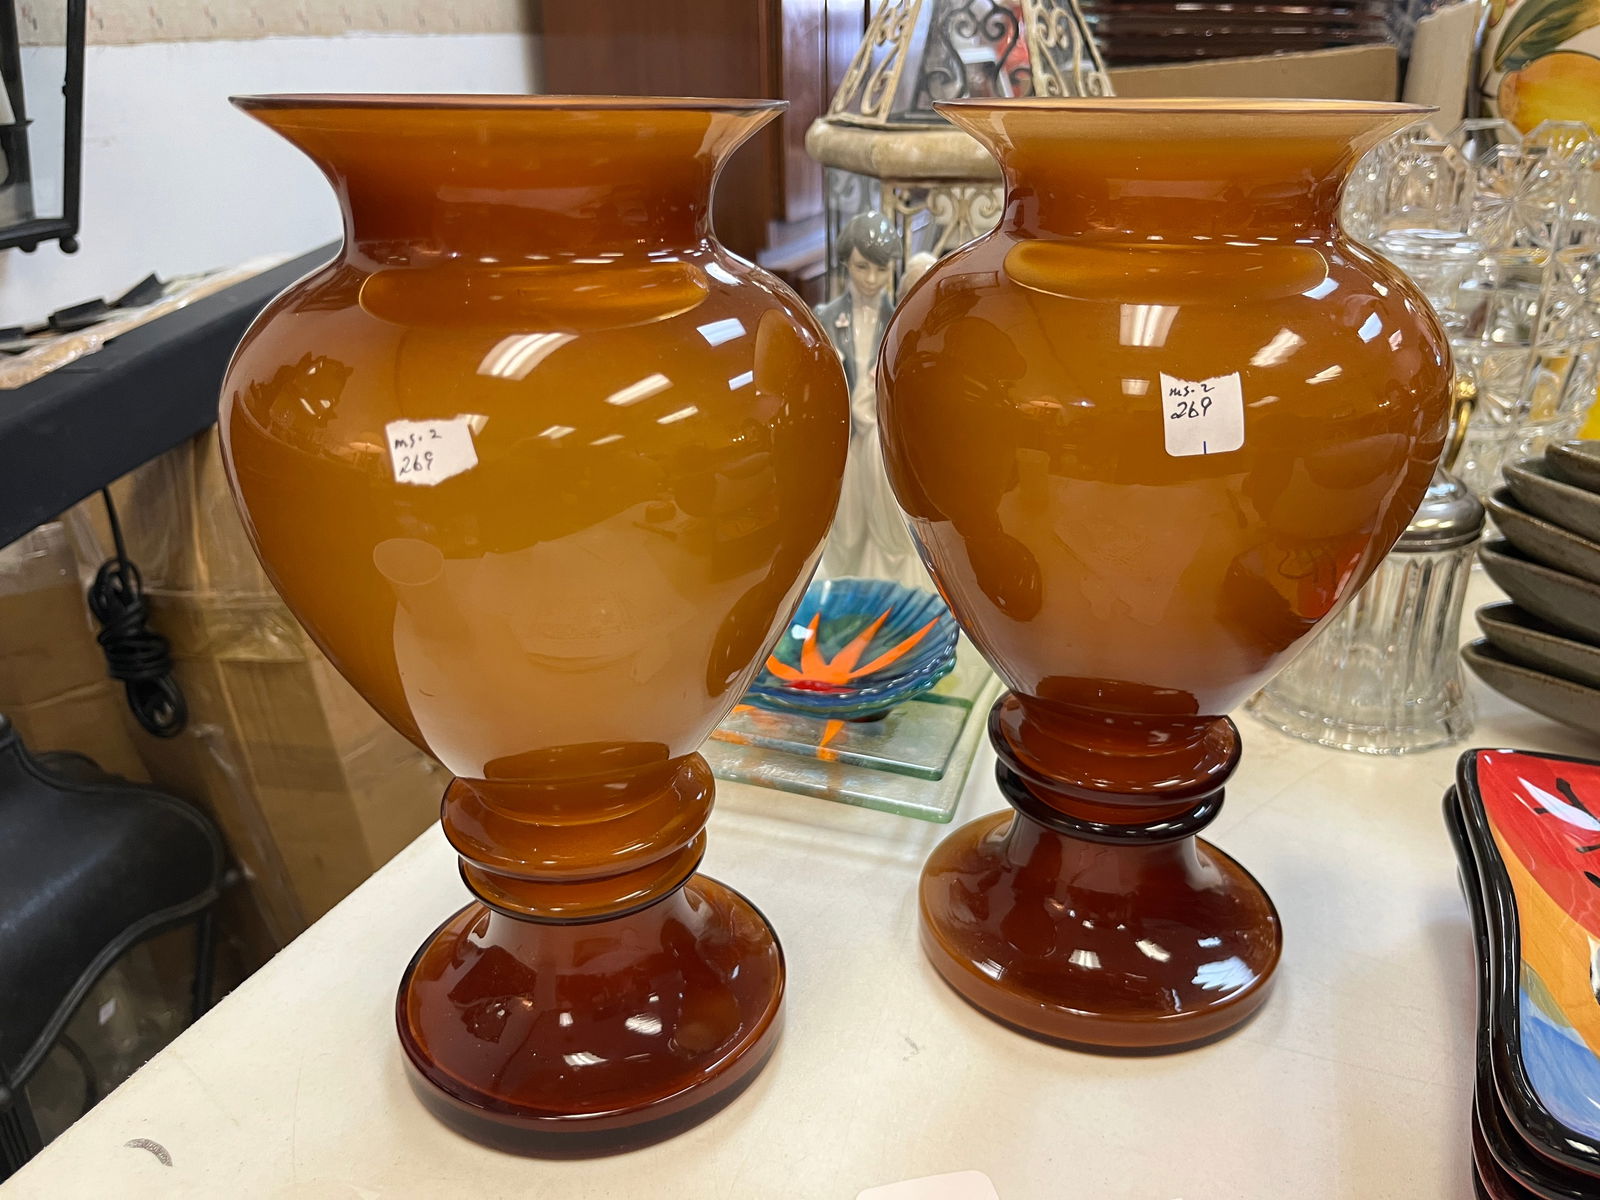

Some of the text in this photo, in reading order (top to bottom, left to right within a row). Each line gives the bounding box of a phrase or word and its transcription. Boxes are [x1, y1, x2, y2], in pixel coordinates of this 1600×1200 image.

[1200, 383, 1215, 393] 2
[1170, 396, 1213, 420] 269
[429, 428, 442, 439] 2
[399, 451, 434, 477] 269
